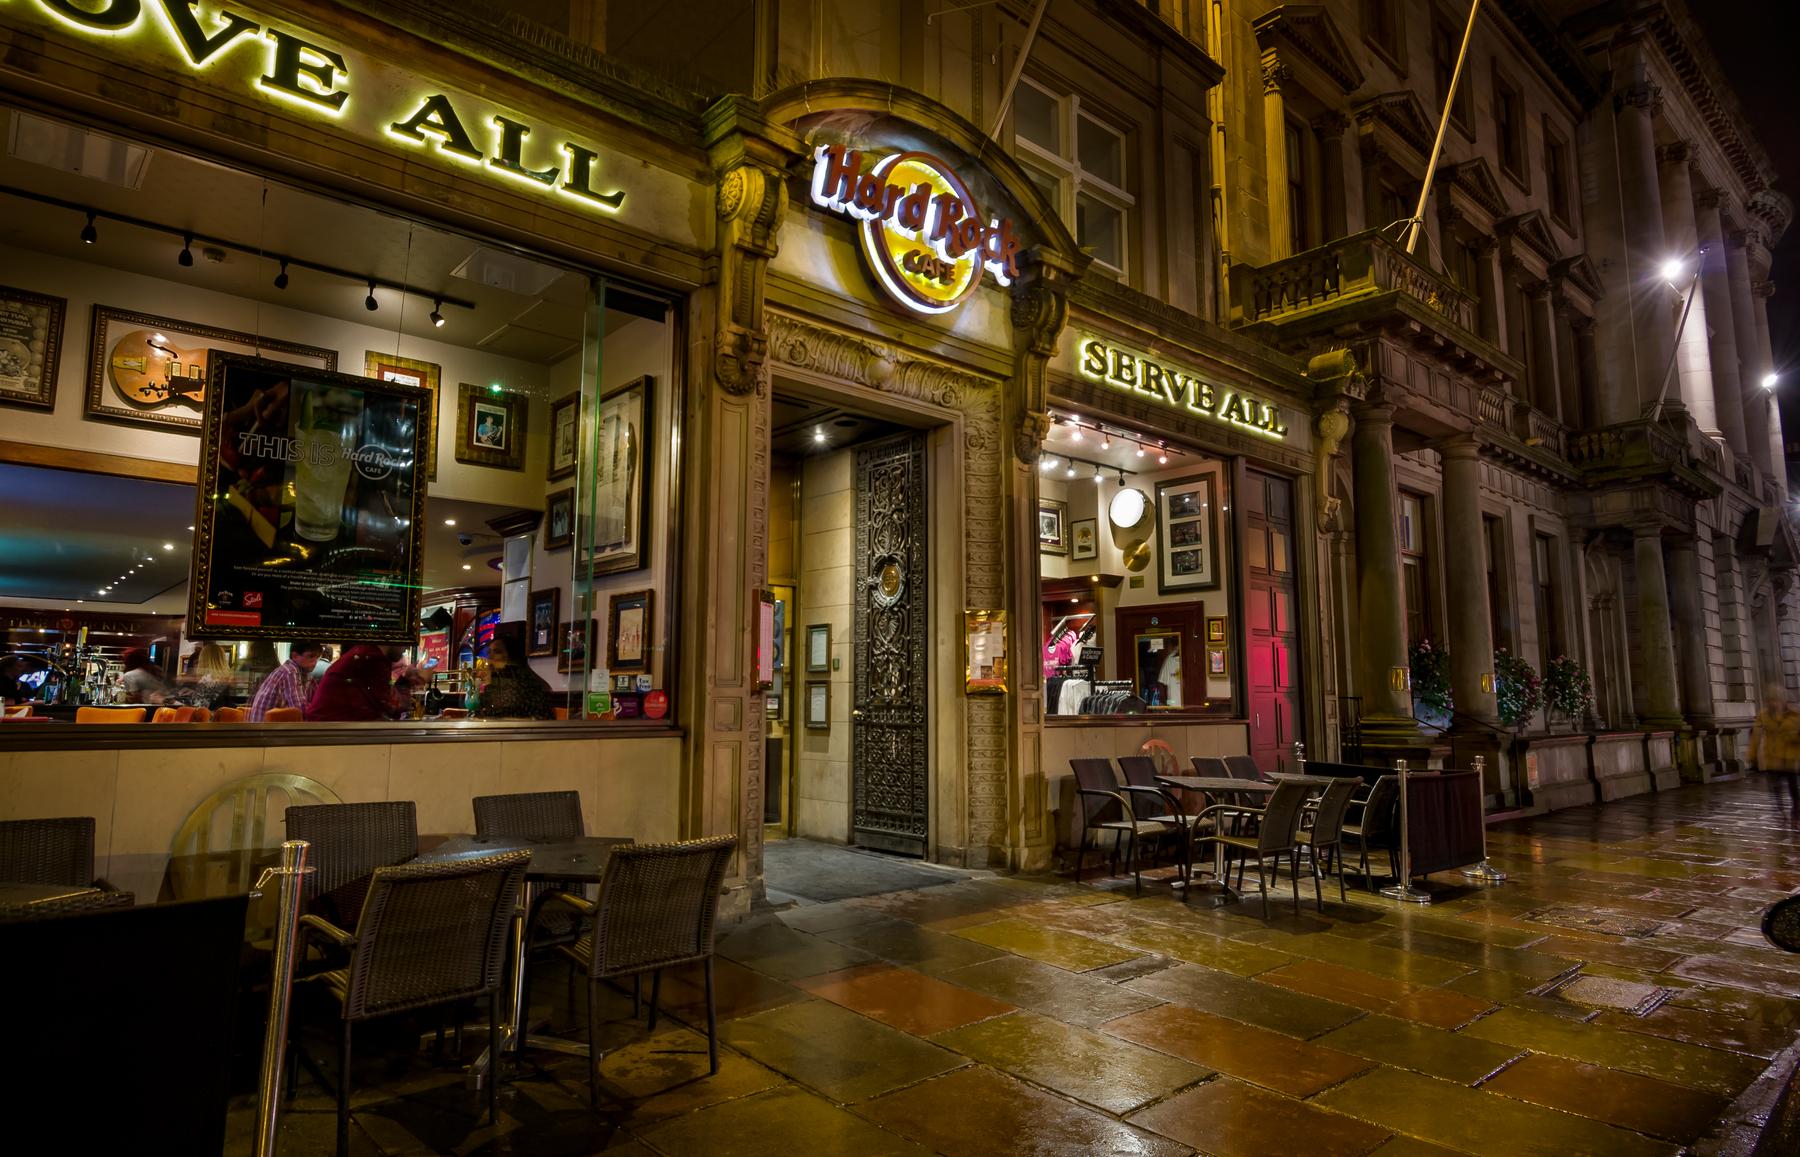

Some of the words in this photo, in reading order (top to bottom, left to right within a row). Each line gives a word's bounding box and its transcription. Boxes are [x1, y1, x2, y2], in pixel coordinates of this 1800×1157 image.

[390, 94, 626, 211] ALL
[820, 143, 932, 231] Hard
[930, 191, 1021, 279] Rock
[903, 249, 956, 286] CAFE
[1083, 340, 1217, 414] SERVE
[1220, 393, 1289, 437] ALL
[239, 432, 305, 462] THIS
[310, 441, 336, 466] IS
[341, 448, 374, 464] Hard
[365, 466, 382, 475] CAFE
